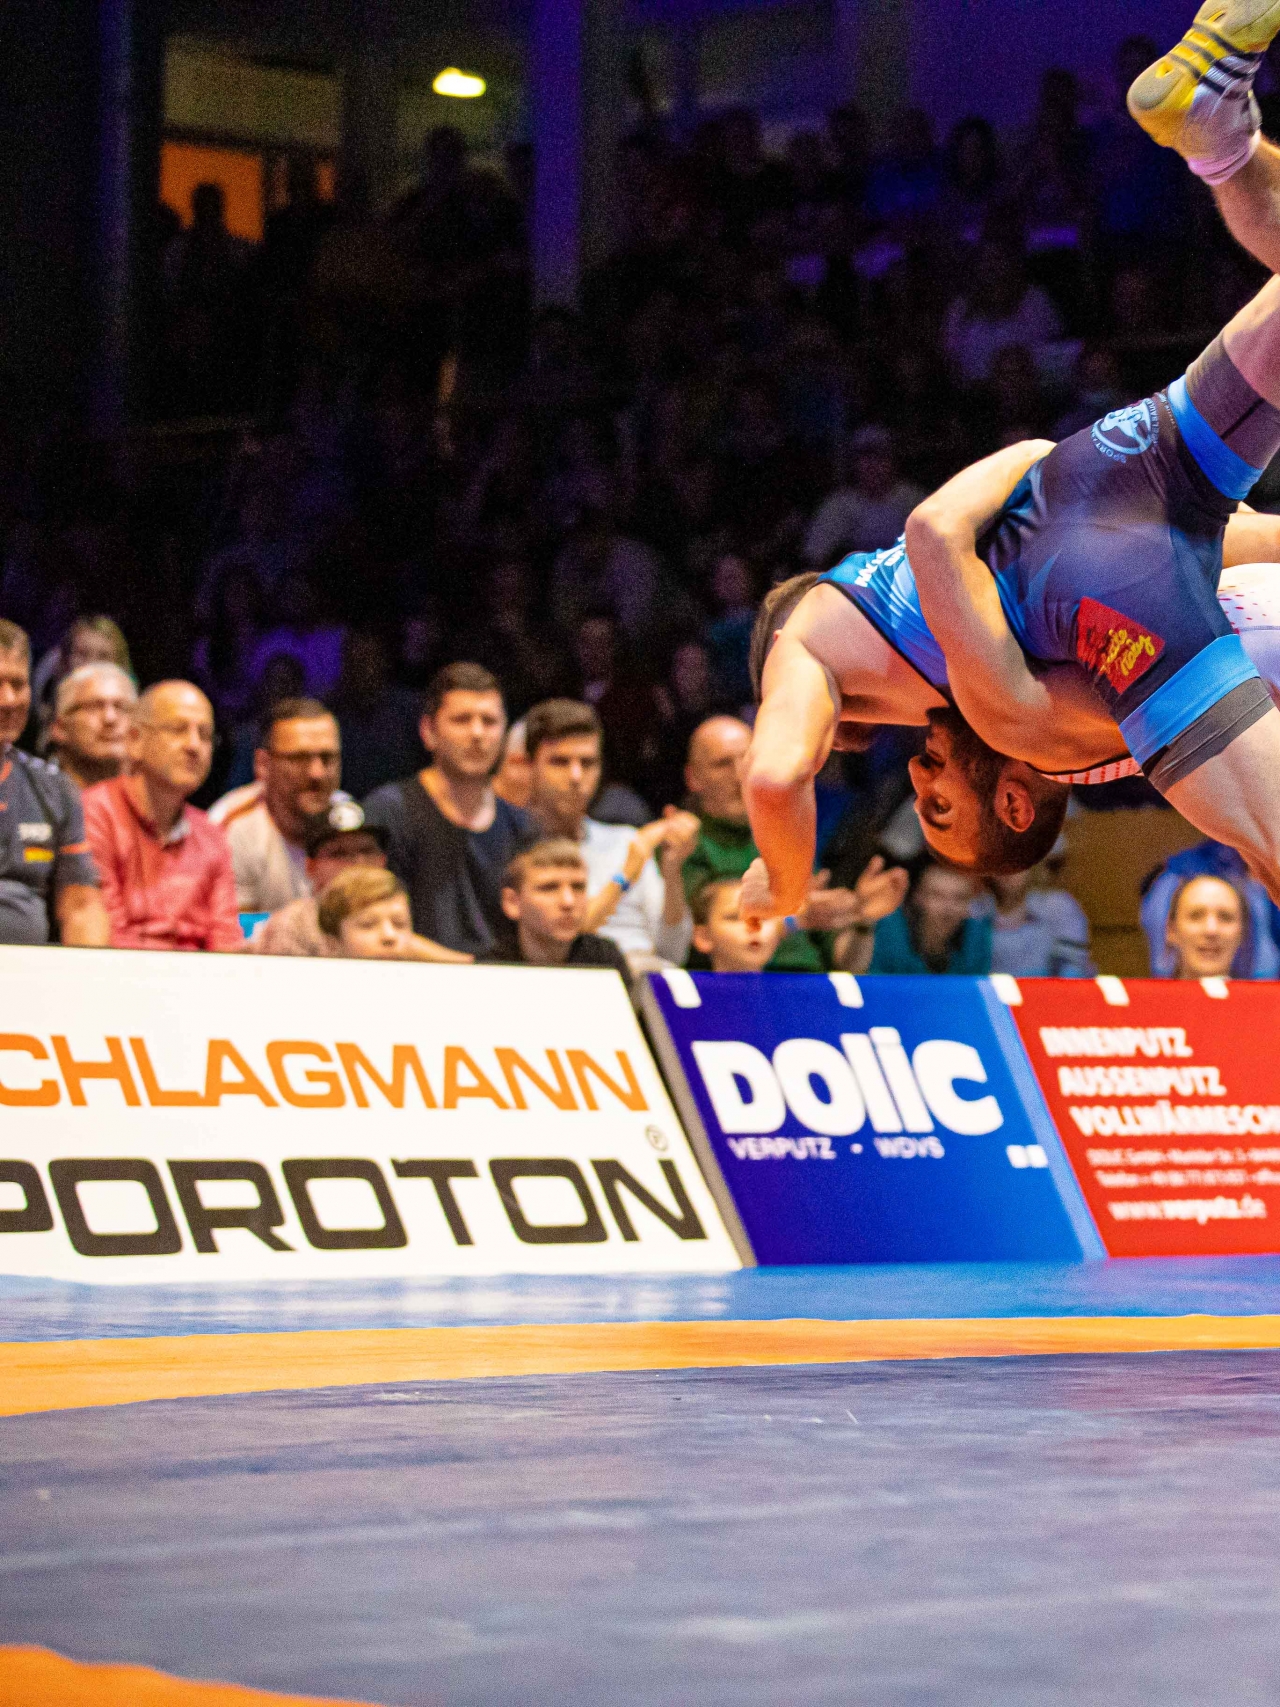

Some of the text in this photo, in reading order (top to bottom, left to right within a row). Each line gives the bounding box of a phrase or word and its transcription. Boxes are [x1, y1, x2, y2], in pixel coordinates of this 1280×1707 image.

[1039, 1027, 1193, 1057] INNENPUTZ
[0, 1032, 649, 1111] CHLAGMANN
[1057, 1066, 1227, 1097] AUSSENPUTZ
[727, 1136, 945, 1160] VERPUTZ WDVS
